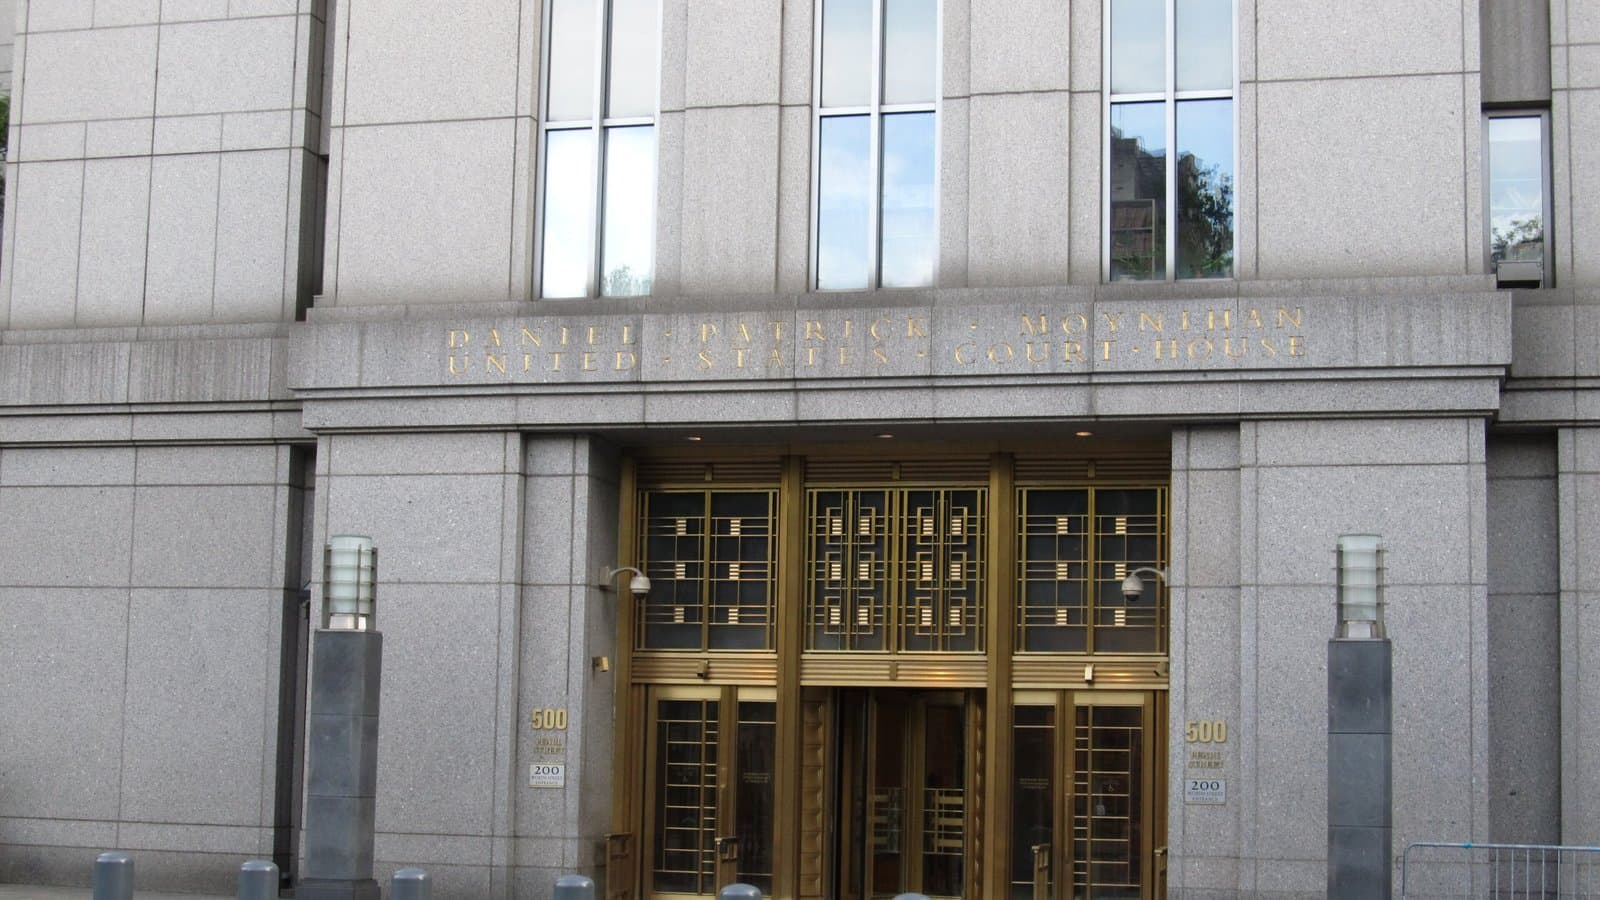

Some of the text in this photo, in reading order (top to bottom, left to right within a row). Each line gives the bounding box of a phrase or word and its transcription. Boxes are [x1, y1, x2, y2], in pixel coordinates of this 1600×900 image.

[449, 306, 1304, 349] DANIEL PATRICK MOYNIHAN
[449, 335, 1306, 377] UNITED STATES COURT HOUSE
[531, 707, 567, 729] 500
[1185, 719, 1227, 742] 500
[535, 766, 559, 775] 200
[1191, 780, 1220, 791] 200
